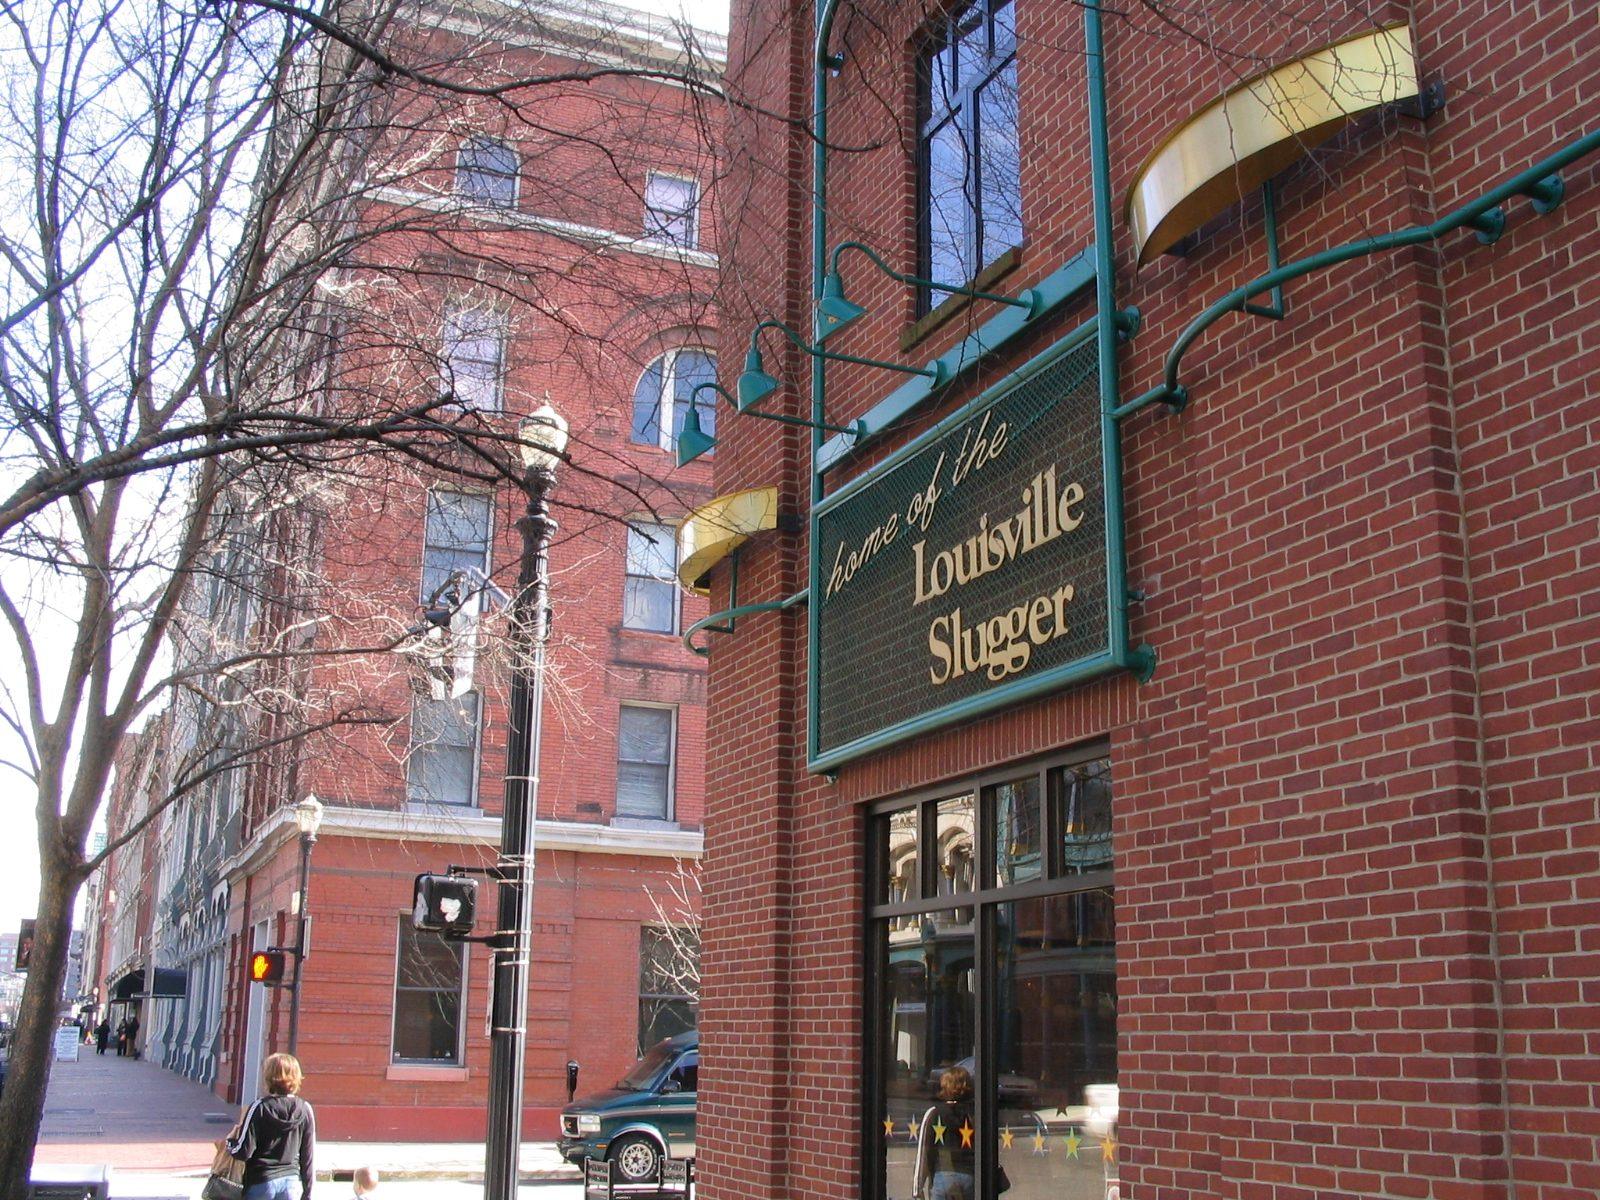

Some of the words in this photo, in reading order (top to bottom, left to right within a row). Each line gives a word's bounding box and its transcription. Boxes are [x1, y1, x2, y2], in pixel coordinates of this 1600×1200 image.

[825, 512, 899, 600] home
[906, 451, 945, 532] of
[952, 410, 1009, 487] the
[912, 462, 1085, 606] Louisville
[929, 584, 1075, 685] Slugger
